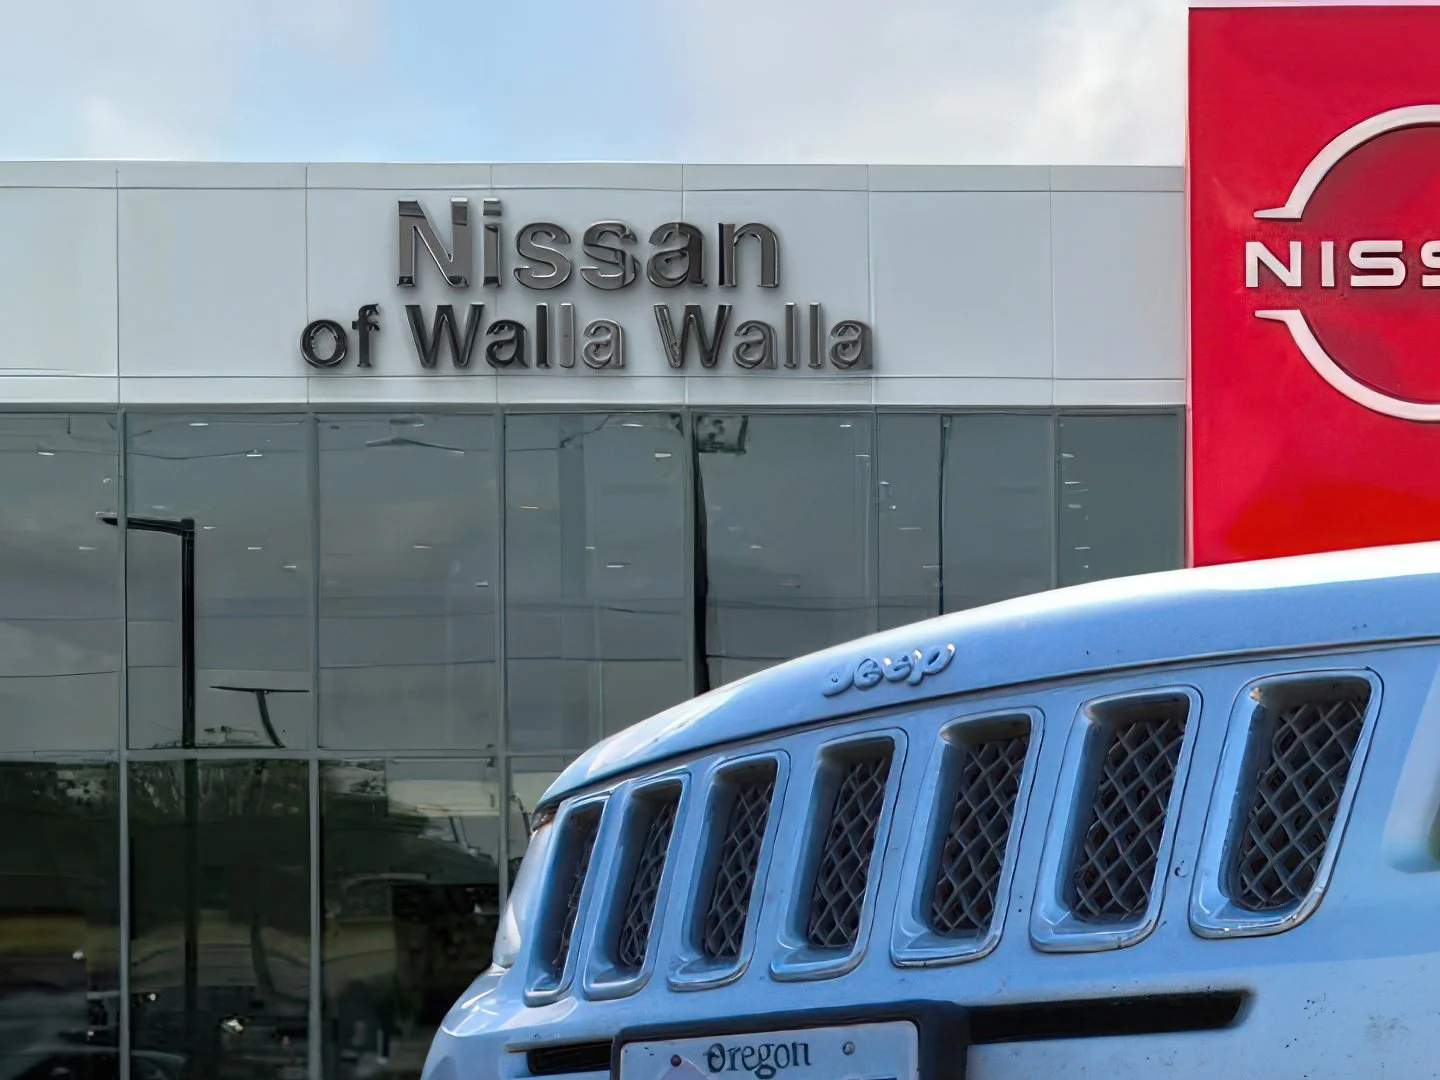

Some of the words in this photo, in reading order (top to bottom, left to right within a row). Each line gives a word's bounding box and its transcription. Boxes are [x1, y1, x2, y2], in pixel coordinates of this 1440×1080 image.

[397, 197, 781, 291] Nissan
[301, 303, 381, 368] of
[404, 302, 626, 370] Walla
[653, 302, 873, 370] Walla
[703, 1041, 812, 1080] Oregon
